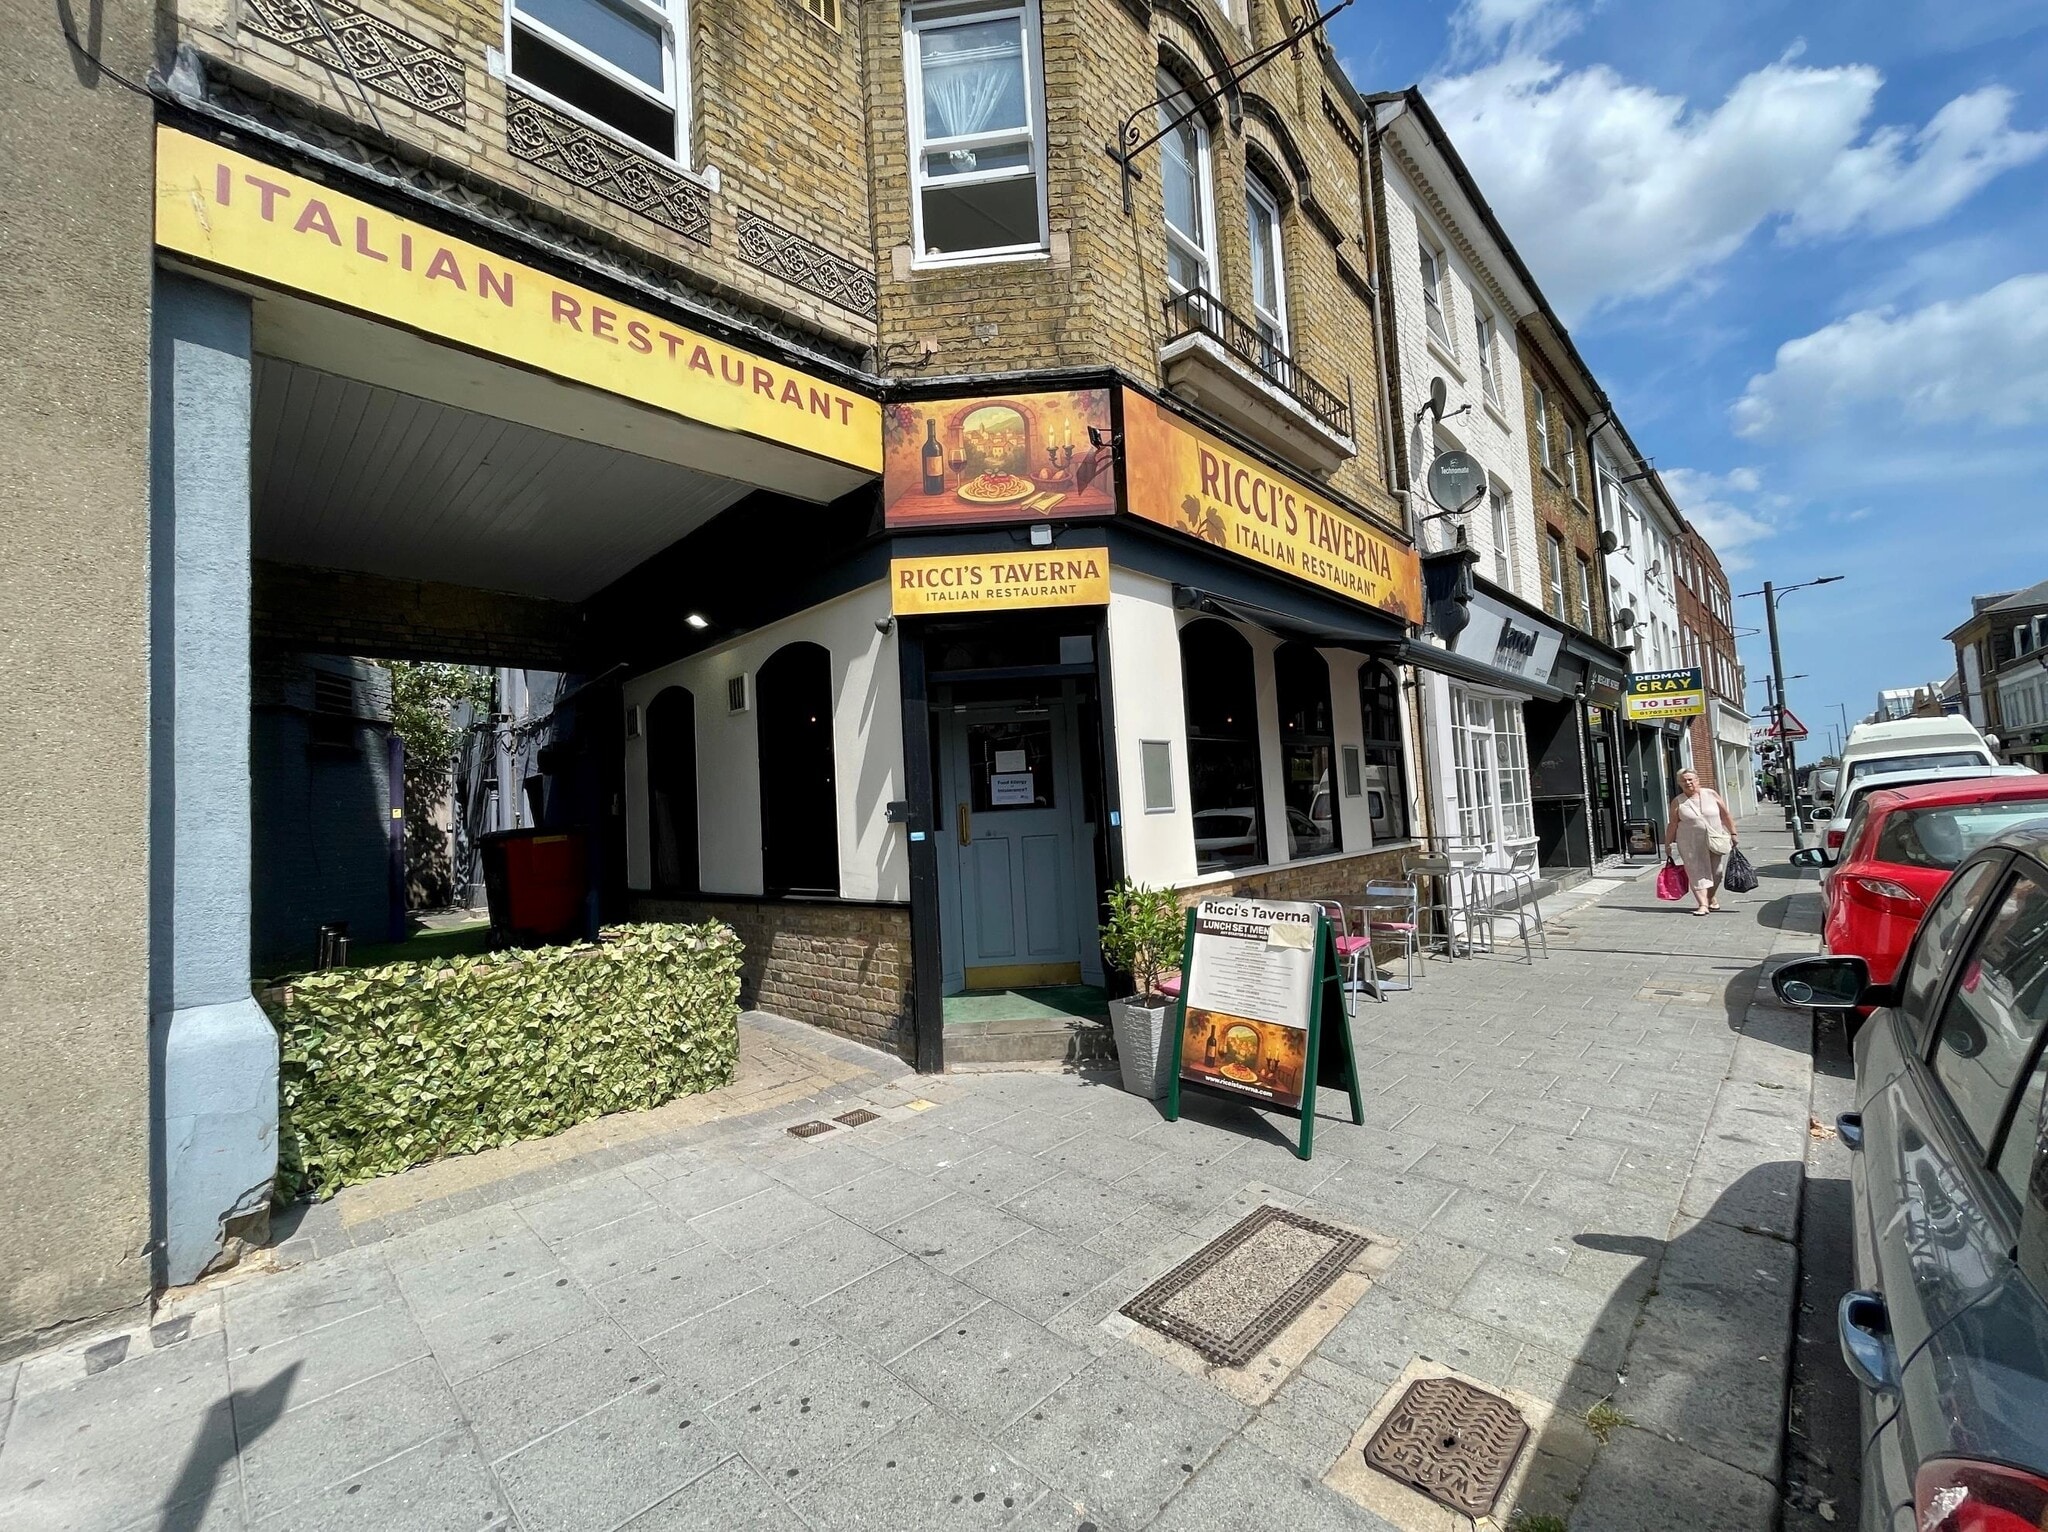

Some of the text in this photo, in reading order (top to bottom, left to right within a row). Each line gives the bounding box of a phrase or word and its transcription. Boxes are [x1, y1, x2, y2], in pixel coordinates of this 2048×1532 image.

[216, 163, 854, 426] ITALIAN RESTAURANT
[1200, 447, 1392, 581] RICCI'S TAVERNA
[1236, 523, 1377, 599] ITALIAN RESTAURANT
[900, 559, 1100, 589] RICCI'S TAVERNA
[926, 584, 1077, 602] ITALIAN RESTAURANT
[1635, 671, 1691, 681] DEDMAN
[1636, 678, 1691, 692] GRAY
[1640, 697, 1690, 708] TO LET
[1204, 902, 1310, 924] Ricci's Taverna
[1203, 920, 1270, 936] LUNCH SET MEN
[1393, 1446, 1470, 1495] WATER
